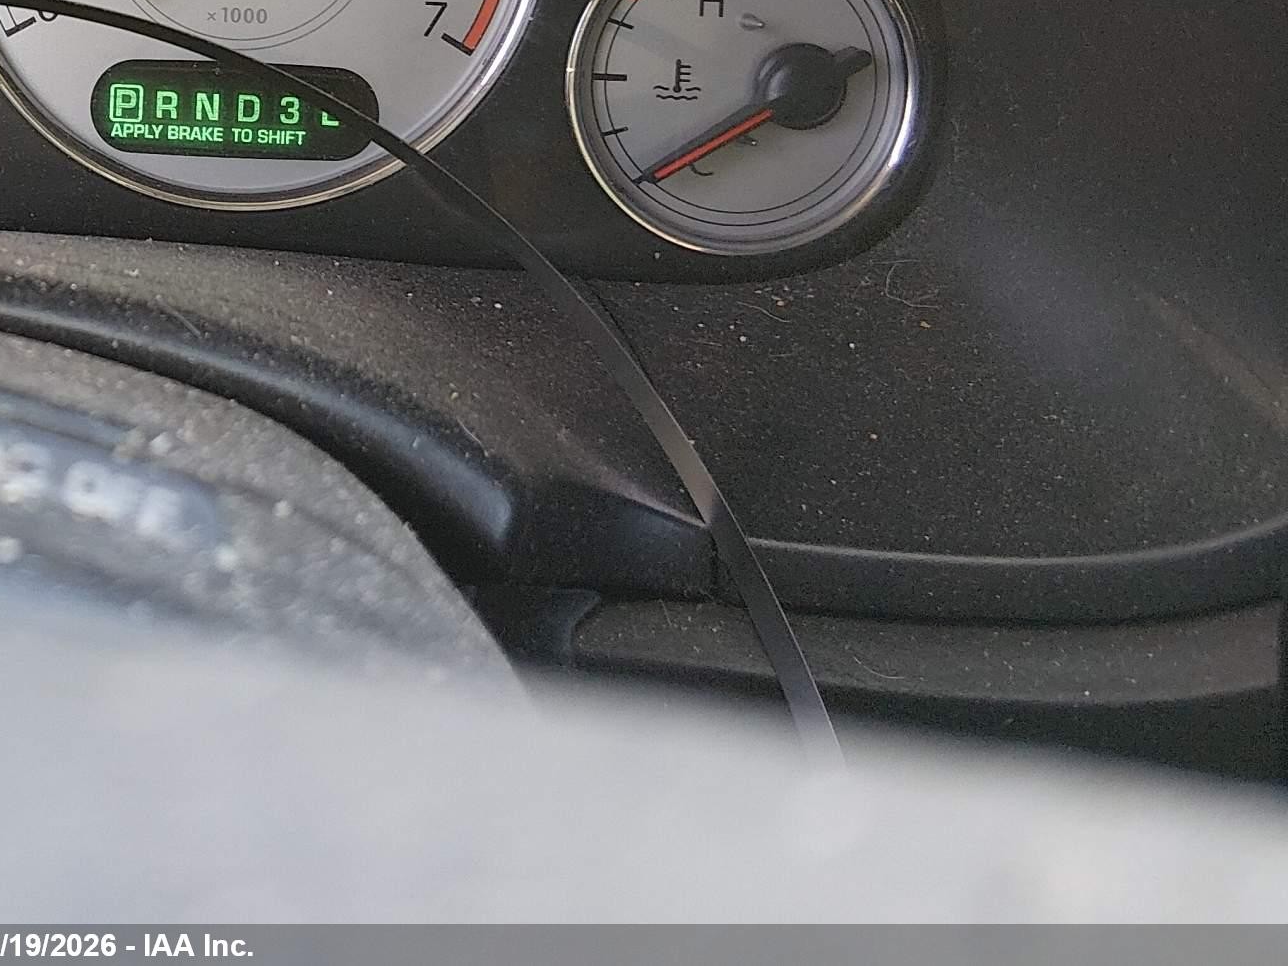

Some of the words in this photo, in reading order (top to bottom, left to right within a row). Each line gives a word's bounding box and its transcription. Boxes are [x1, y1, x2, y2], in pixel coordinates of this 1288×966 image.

[423, 1, 450, 37] 7
[114, 88, 138, 118] P
[155, 90, 179, 120] R
[195, 92, 221, 122] N
[237, 94, 261, 123] D
[279, 96, 301, 125] 3
[110, 122, 164, 140] APPLY
[166, 124, 224, 143] BRAKE
[231, 127, 254, 144] TO
[256, 129, 307, 147] SHIFT
